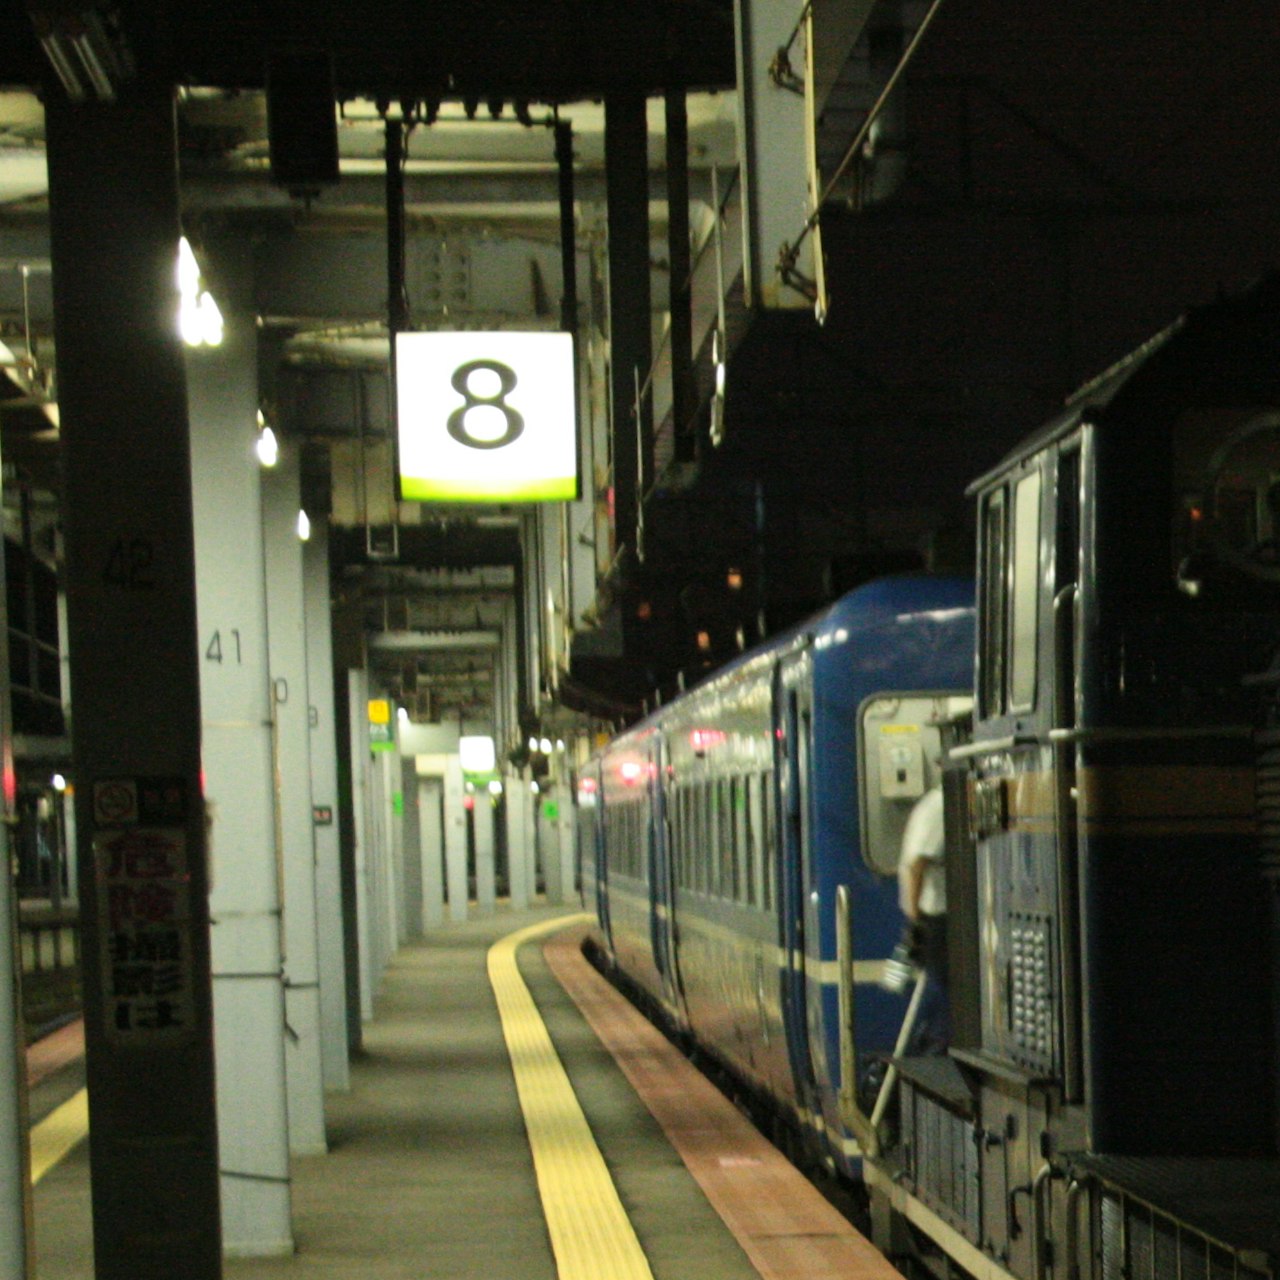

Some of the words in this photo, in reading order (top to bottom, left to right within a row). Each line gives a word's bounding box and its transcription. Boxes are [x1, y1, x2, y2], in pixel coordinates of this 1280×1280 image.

[446, 358, 525, 451] 8
[98, 536, 154, 582] 42
[205, 628, 242, 665] 41
